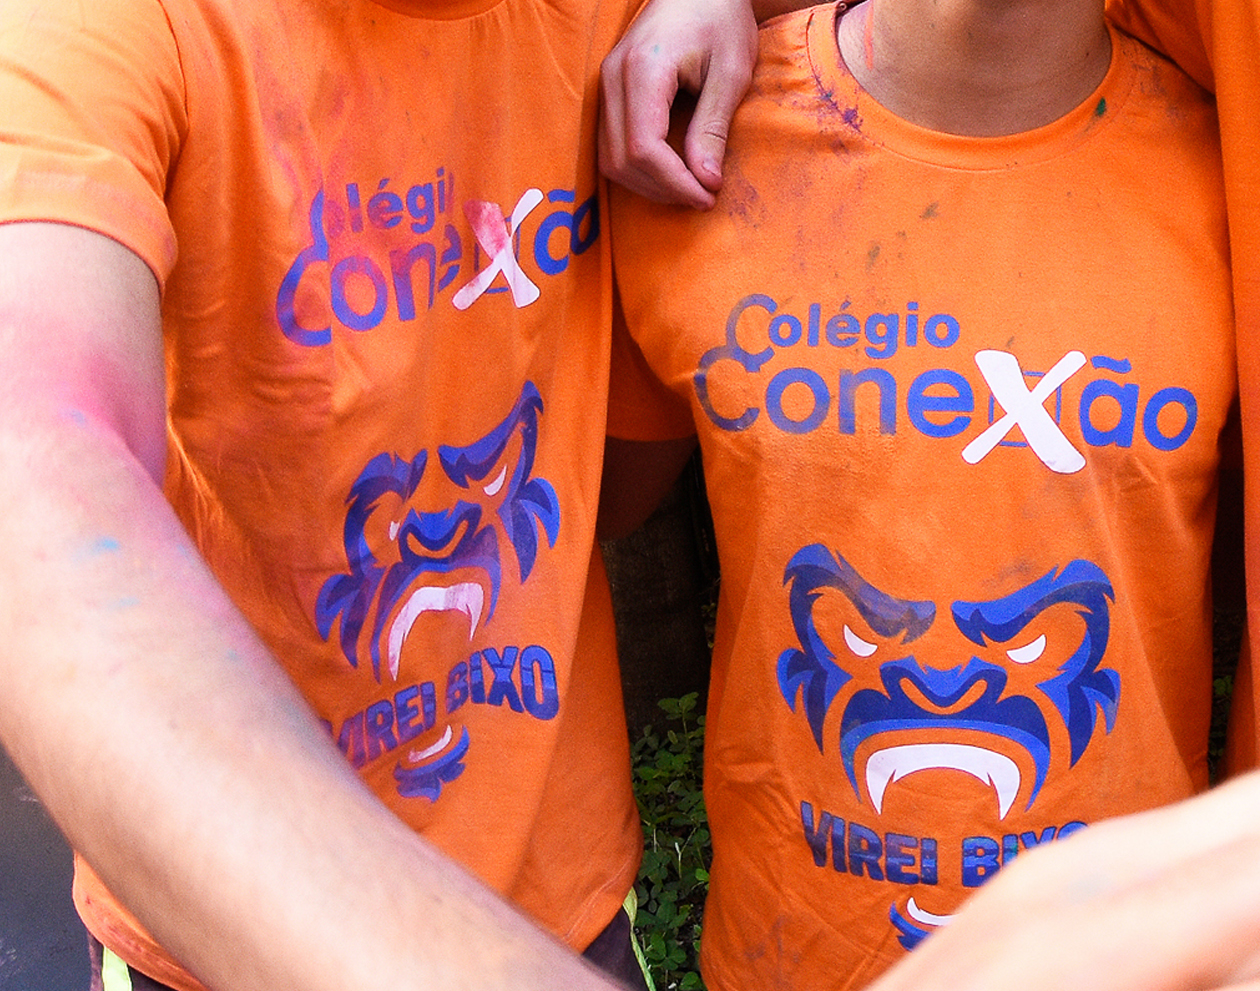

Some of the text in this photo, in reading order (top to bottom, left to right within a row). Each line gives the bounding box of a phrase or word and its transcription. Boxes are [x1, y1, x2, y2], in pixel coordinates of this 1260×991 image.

[308, 167, 455, 261] légi
[725, 293, 961, 372] Colégio
[446, 644, 560, 721] BIXO
[801, 800, 1089, 888] VIREI BI
